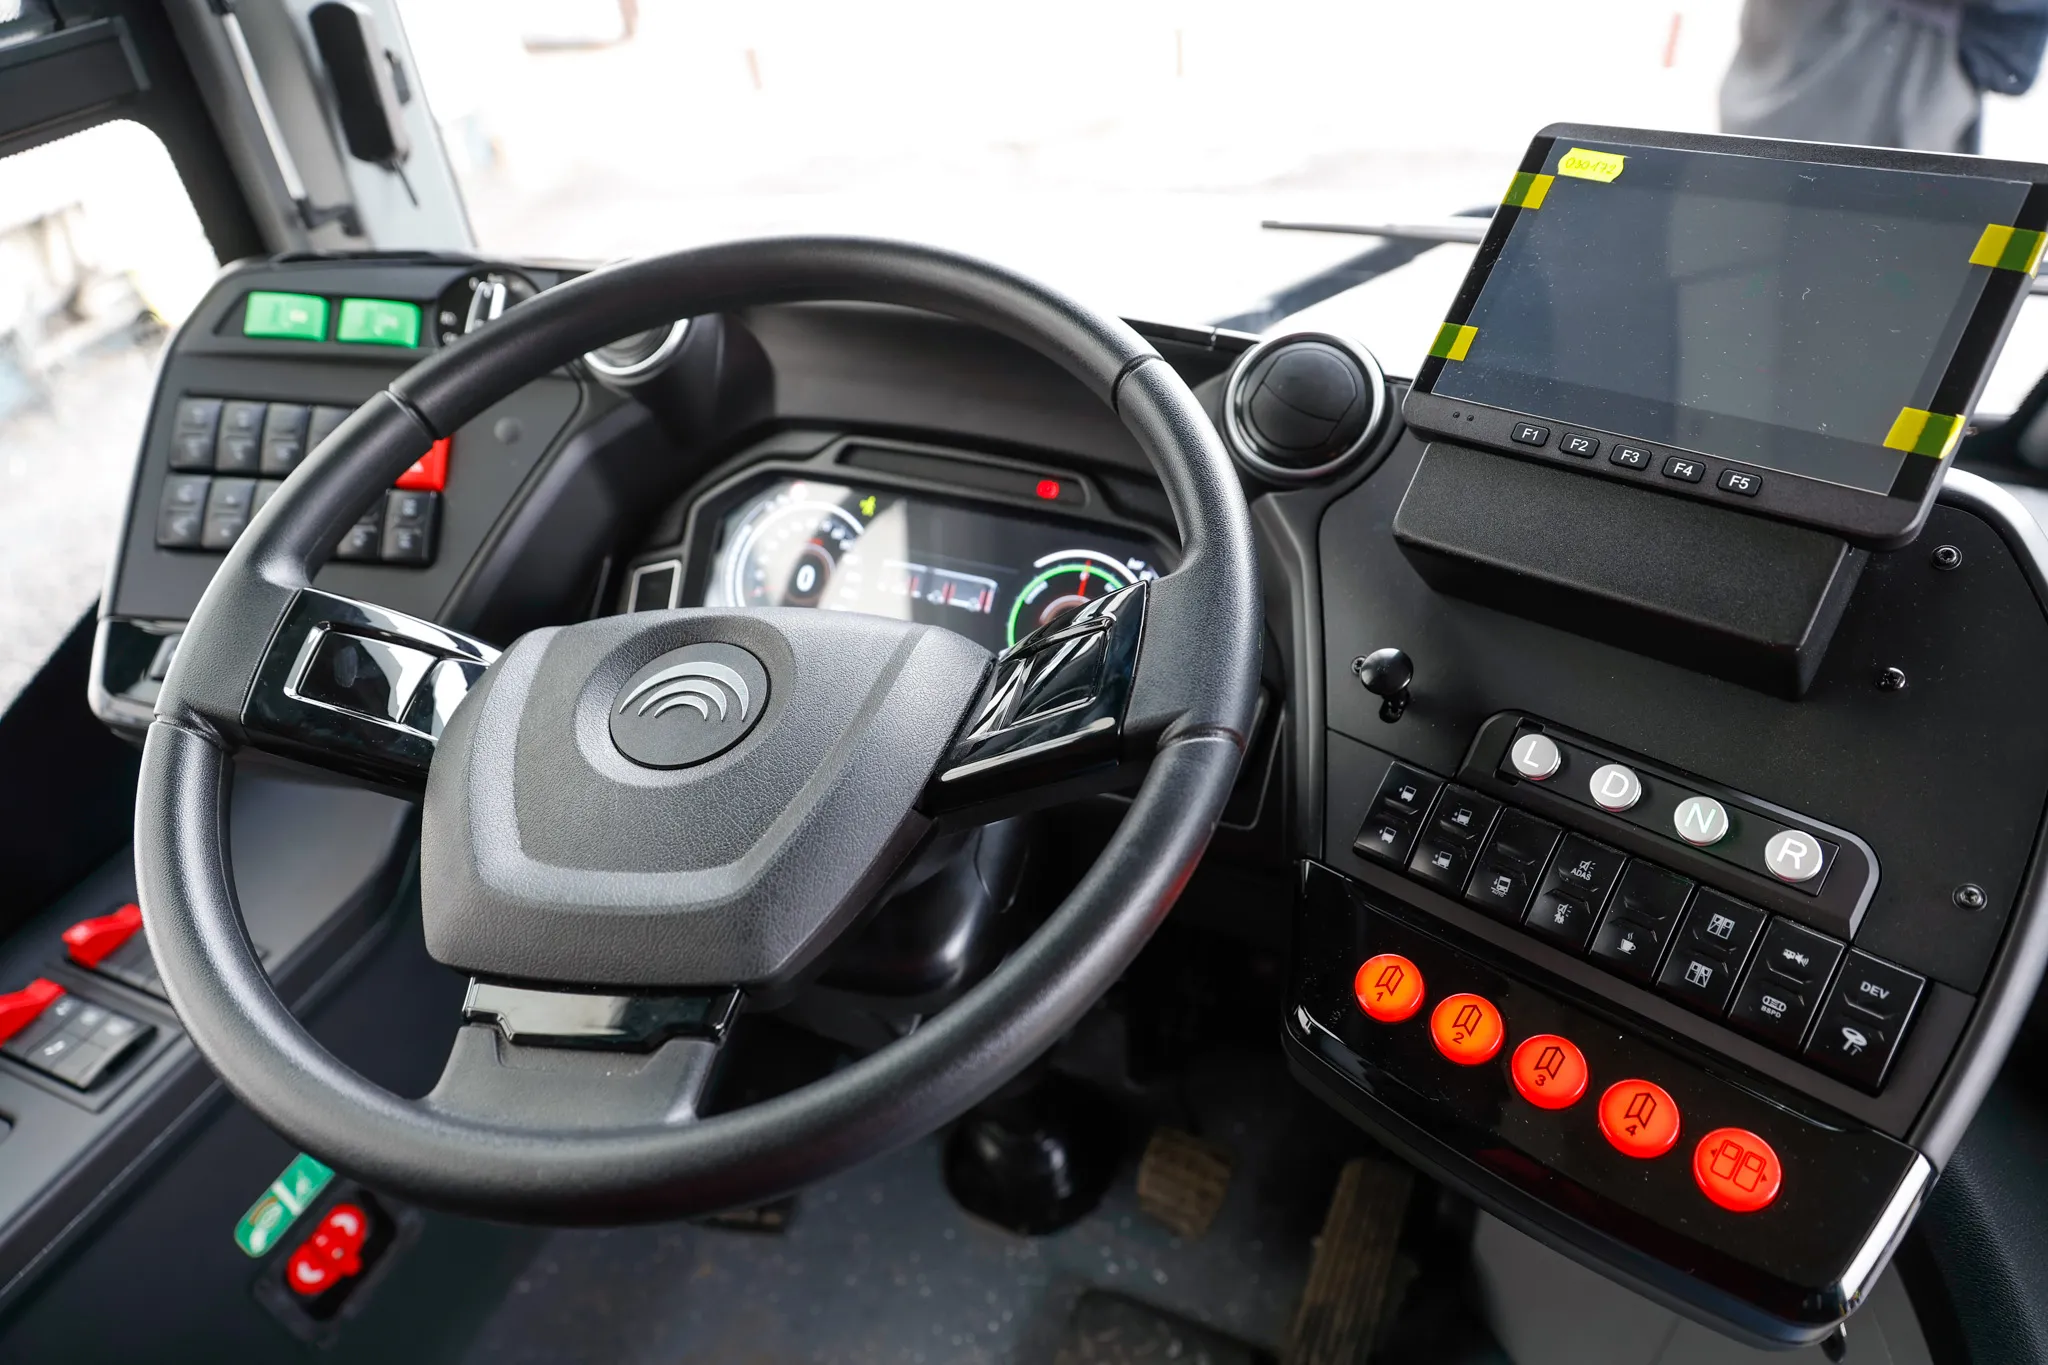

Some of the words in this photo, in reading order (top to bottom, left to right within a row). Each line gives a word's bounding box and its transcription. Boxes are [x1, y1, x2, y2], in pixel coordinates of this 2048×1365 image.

[1522, 428, 1539, 441] F1
[1570, 439, 1589, 452] F2
[1620, 450, 1640, 464] F3
[1674, 462, 1693, 477] F4
[1728, 475, 1749, 489] F5
[1523, 740, 1540, 768] L
[1601, 770, 1629, 798] D
[1684, 802, 1717, 834] N
[1776, 837, 1808, 870] R
[1571, 867, 1592, 881] ADAS
[1375, 991, 1384, 1002] 1
[1860, 981, 1890, 999] DEV
[1452, 1032, 1465, 1044] 2
[1535, 1074, 1547, 1087] 3
[1625, 1124, 1638, 1137] 4
